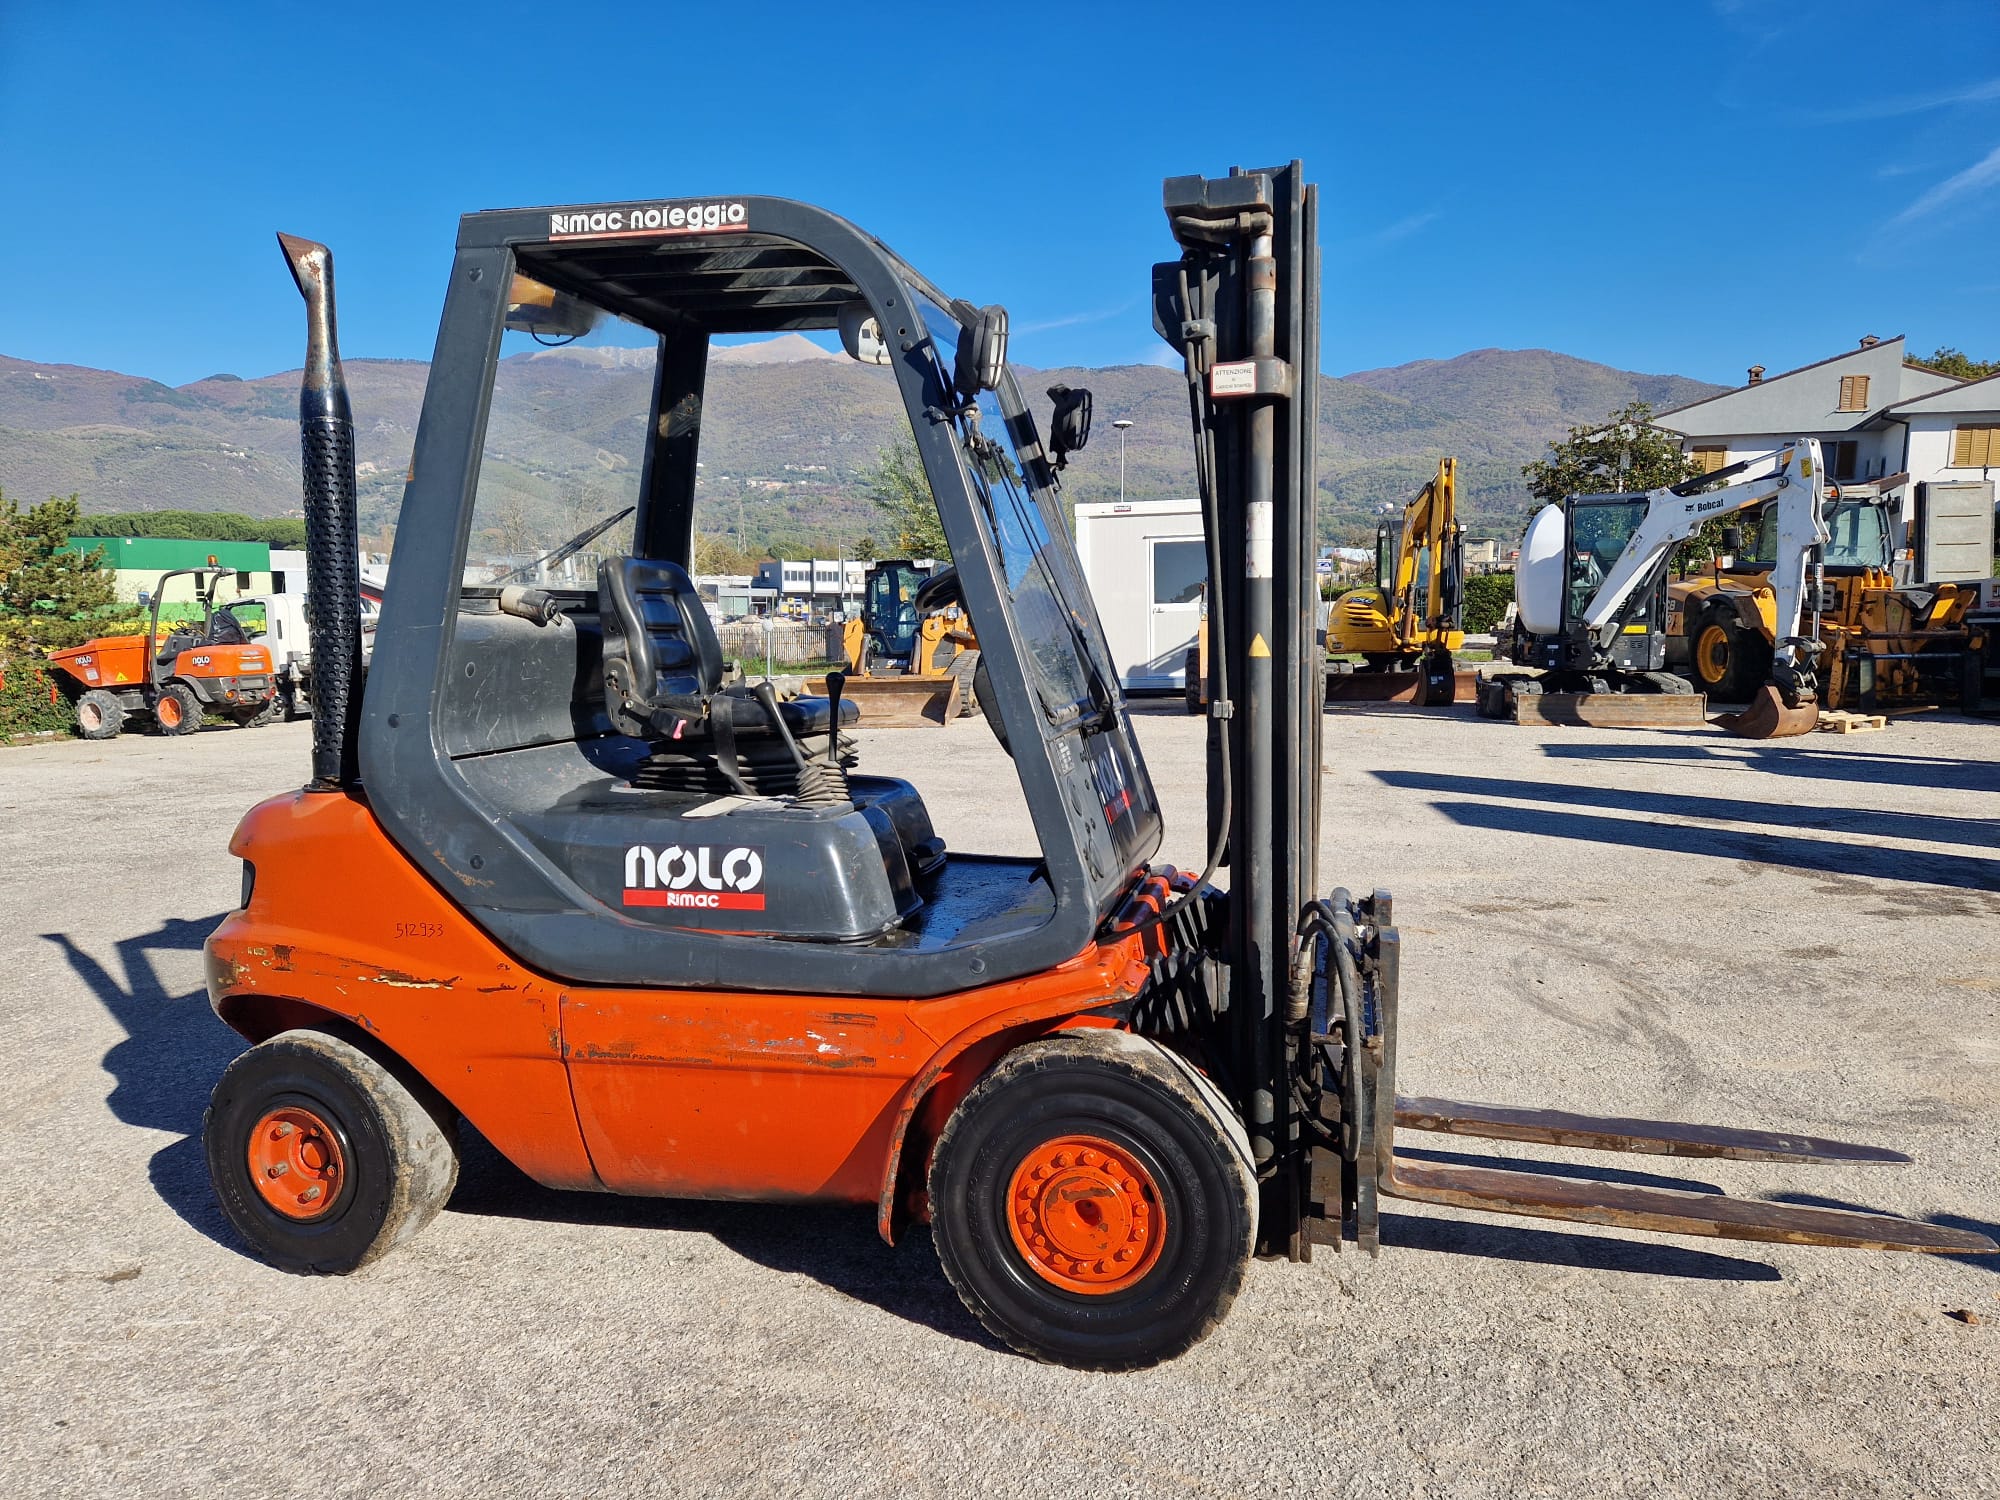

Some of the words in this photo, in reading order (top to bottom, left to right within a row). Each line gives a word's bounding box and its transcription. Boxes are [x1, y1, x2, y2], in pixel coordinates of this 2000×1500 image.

[551, 212, 623, 234] Rimac
[630, 203, 746, 232] noleggio
[1697, 498, 1724, 512] Bobcat
[667, 892, 720, 908] Rimac
[394, 922, 444, 939] 512933
